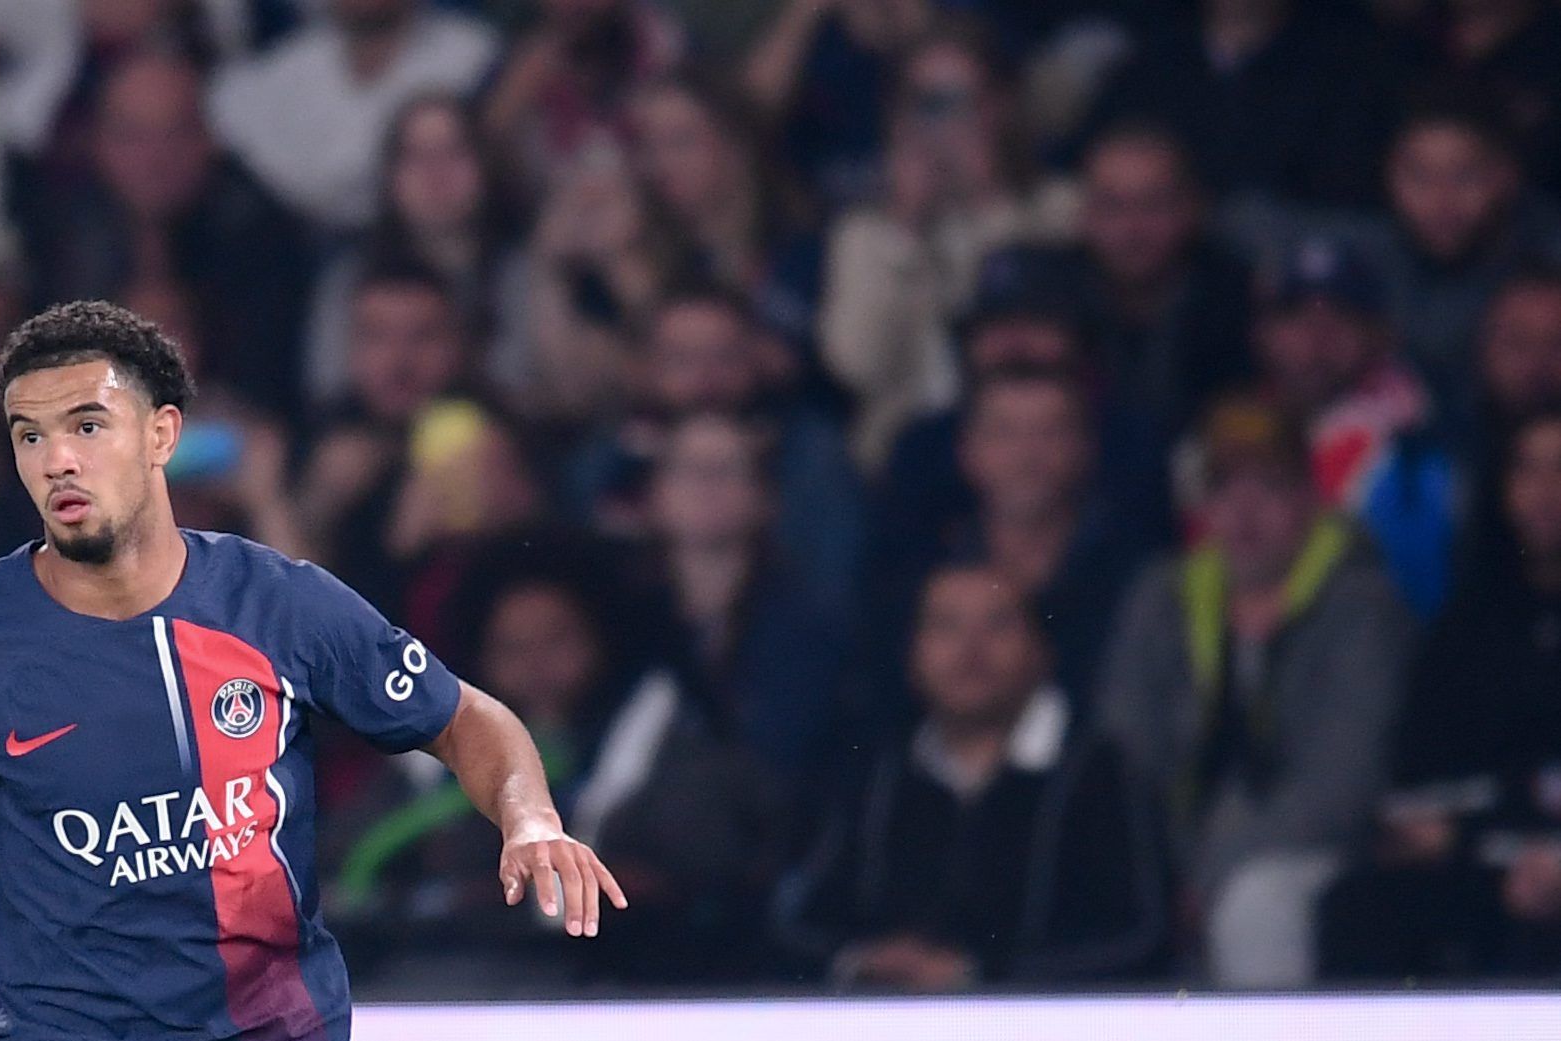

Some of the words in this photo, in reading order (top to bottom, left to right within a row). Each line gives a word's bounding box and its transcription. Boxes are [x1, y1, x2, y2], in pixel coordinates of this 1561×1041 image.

[219, 681, 254, 699] PARIS
[385, 637, 427, 701] GO
[53, 776, 254, 866] QATAR
[110, 820, 258, 887] AIRWAYS
